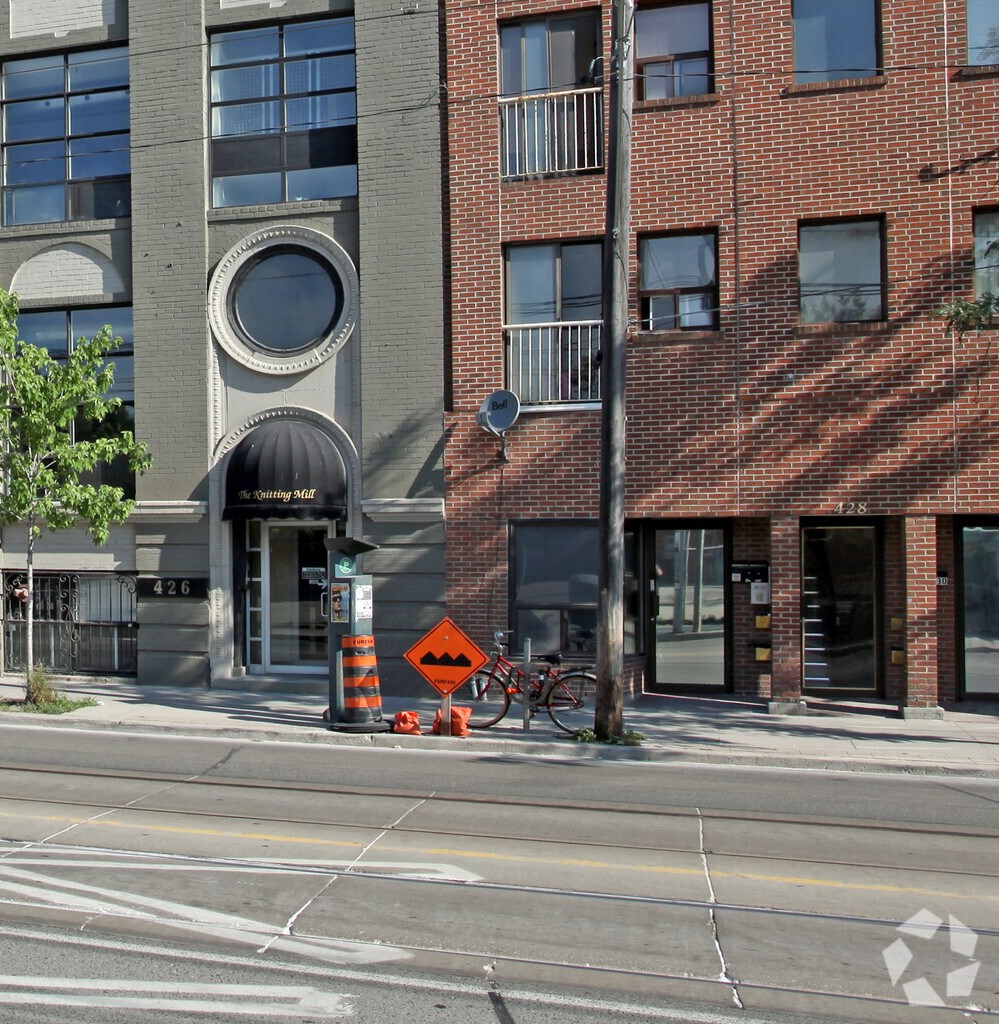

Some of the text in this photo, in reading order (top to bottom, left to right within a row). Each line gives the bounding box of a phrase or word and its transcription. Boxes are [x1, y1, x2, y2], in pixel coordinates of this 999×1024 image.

[492, 399, 508, 411] Bell
[238, 488, 316, 502] The Knitting Mill
[834, 501, 867, 514] 428
[153, 580, 190, 594] 426
